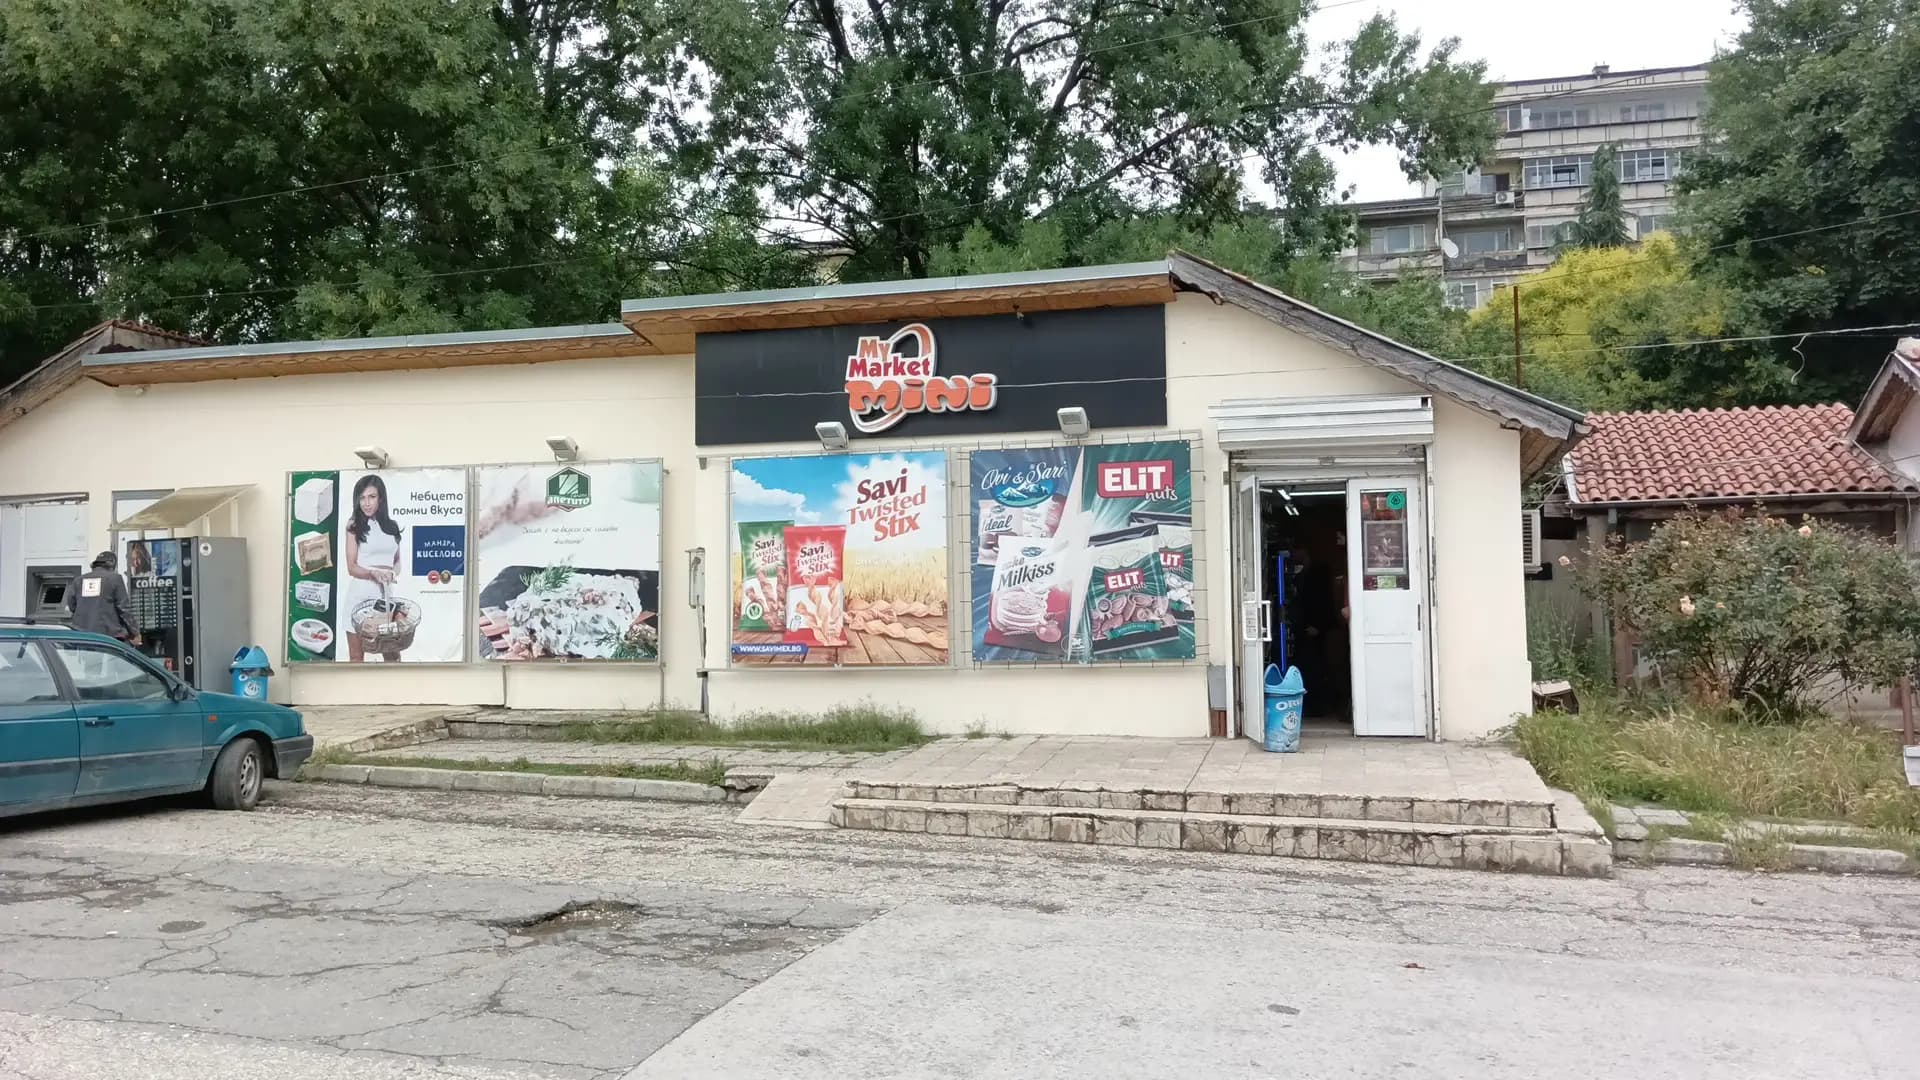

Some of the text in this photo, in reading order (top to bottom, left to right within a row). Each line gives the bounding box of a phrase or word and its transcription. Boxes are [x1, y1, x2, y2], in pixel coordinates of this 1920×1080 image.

[860, 339, 891, 362] My
[848, 357, 931, 377] Market
[1012, 472, 1023, 484] &
[857, 468, 908, 505] Savi
[1144, 486, 1178, 502] nuts
[410, 491, 464, 503] Небцето
[846, 485, 927, 525] Twisted
[392, 504, 464, 517] помни вкуса
[873, 510, 921, 542] Stix
[754, 536, 775, 551] Savi
[799, 542, 825, 558] Savi
[760, 553, 780, 566] Stix
[807, 560, 830, 575] Stix
[136, 575, 174, 588] coffee
[997, 561, 1056, 591] Milkiss
